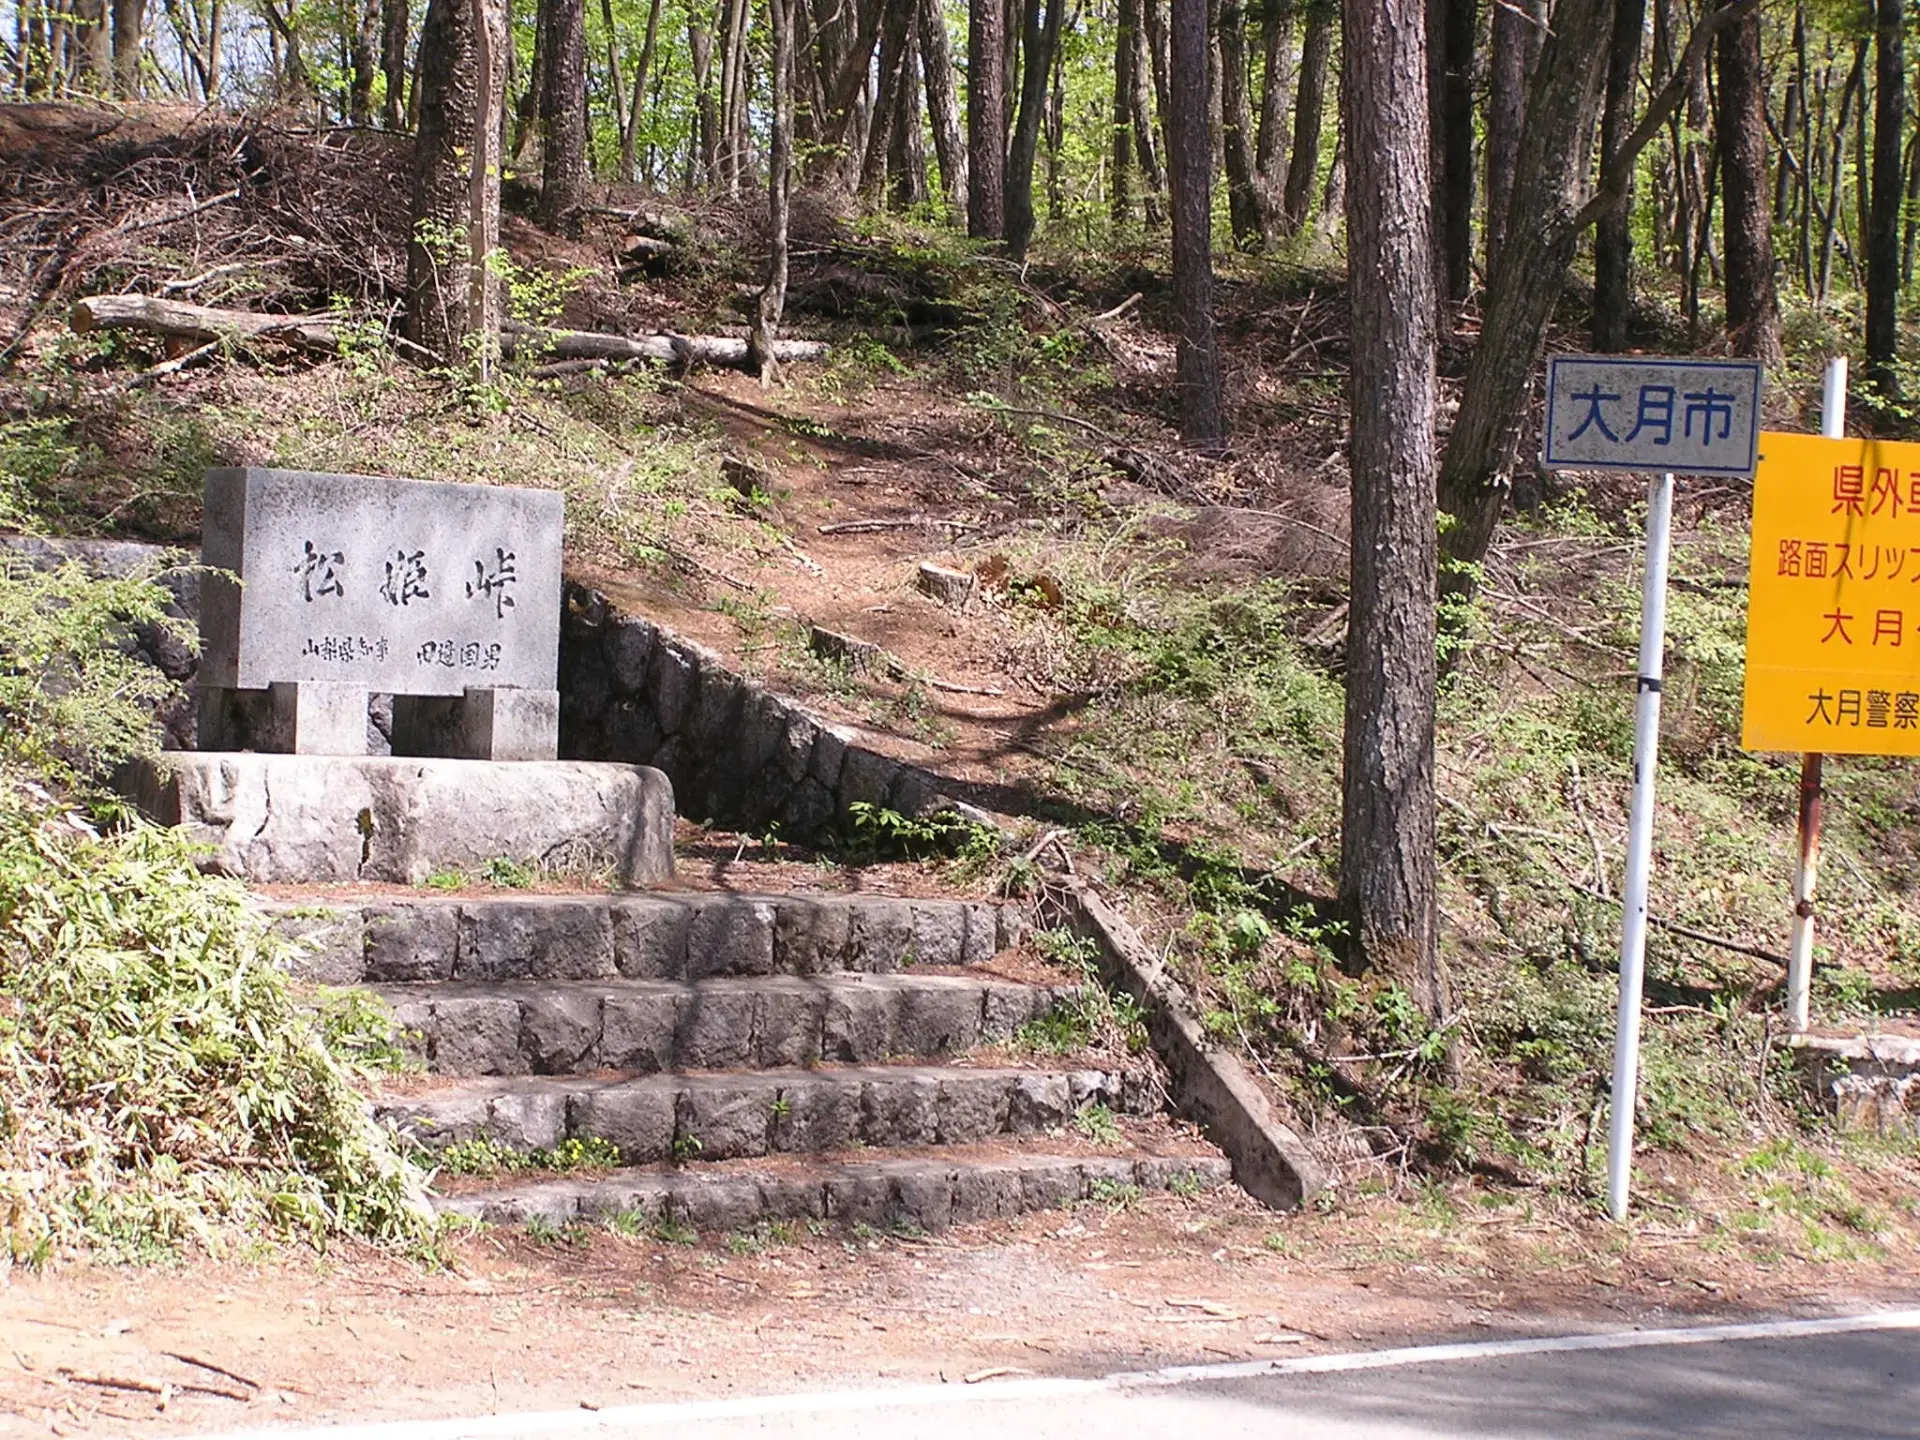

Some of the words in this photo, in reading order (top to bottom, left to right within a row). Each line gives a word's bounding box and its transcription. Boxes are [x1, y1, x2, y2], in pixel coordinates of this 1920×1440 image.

[1568, 383, 1736, 447] 大月市
[1820, 606, 1920, 648] 大月
[1805, 687, 1920, 729] 大月警察
